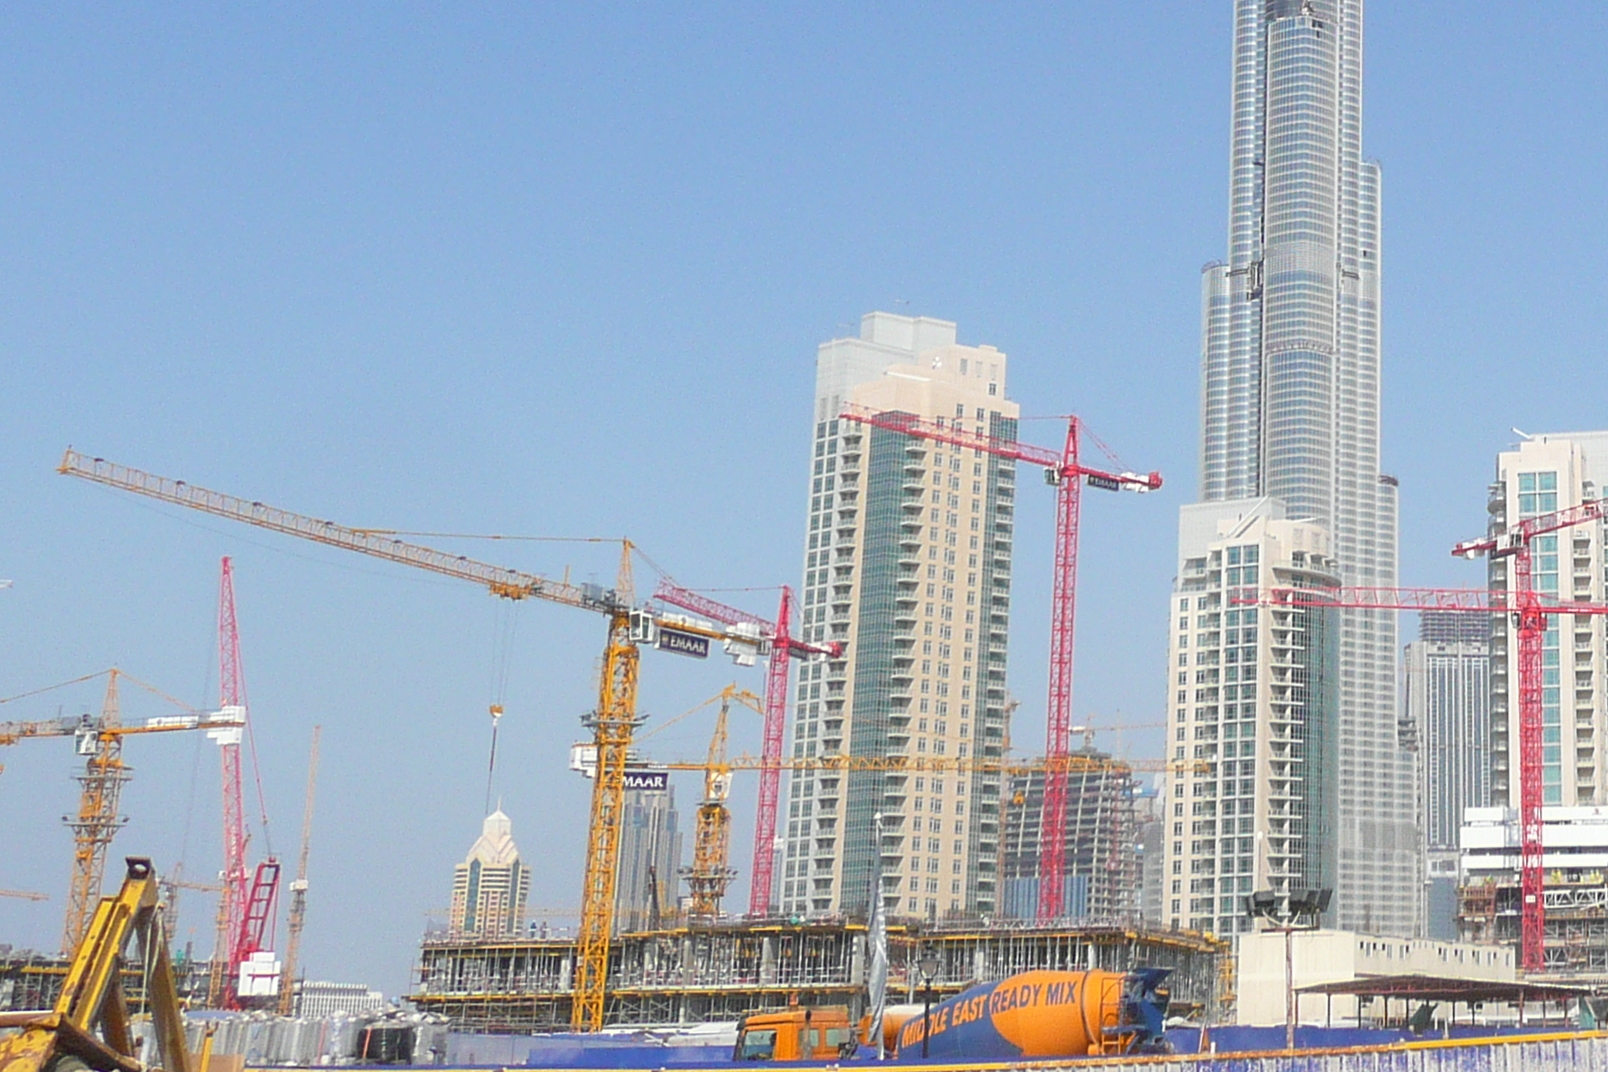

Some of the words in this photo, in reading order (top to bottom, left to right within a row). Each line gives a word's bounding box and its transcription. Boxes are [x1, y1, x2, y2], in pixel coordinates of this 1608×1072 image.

[670, 635, 706, 654] EMAAR
[616, 775, 664, 788] MAAR
[901, 1007, 949, 1048] MIDDLE
[952, 994, 987, 1026] EAST
[991, 984, 1042, 1015] READY
[1045, 981, 1077, 1005] MIX
